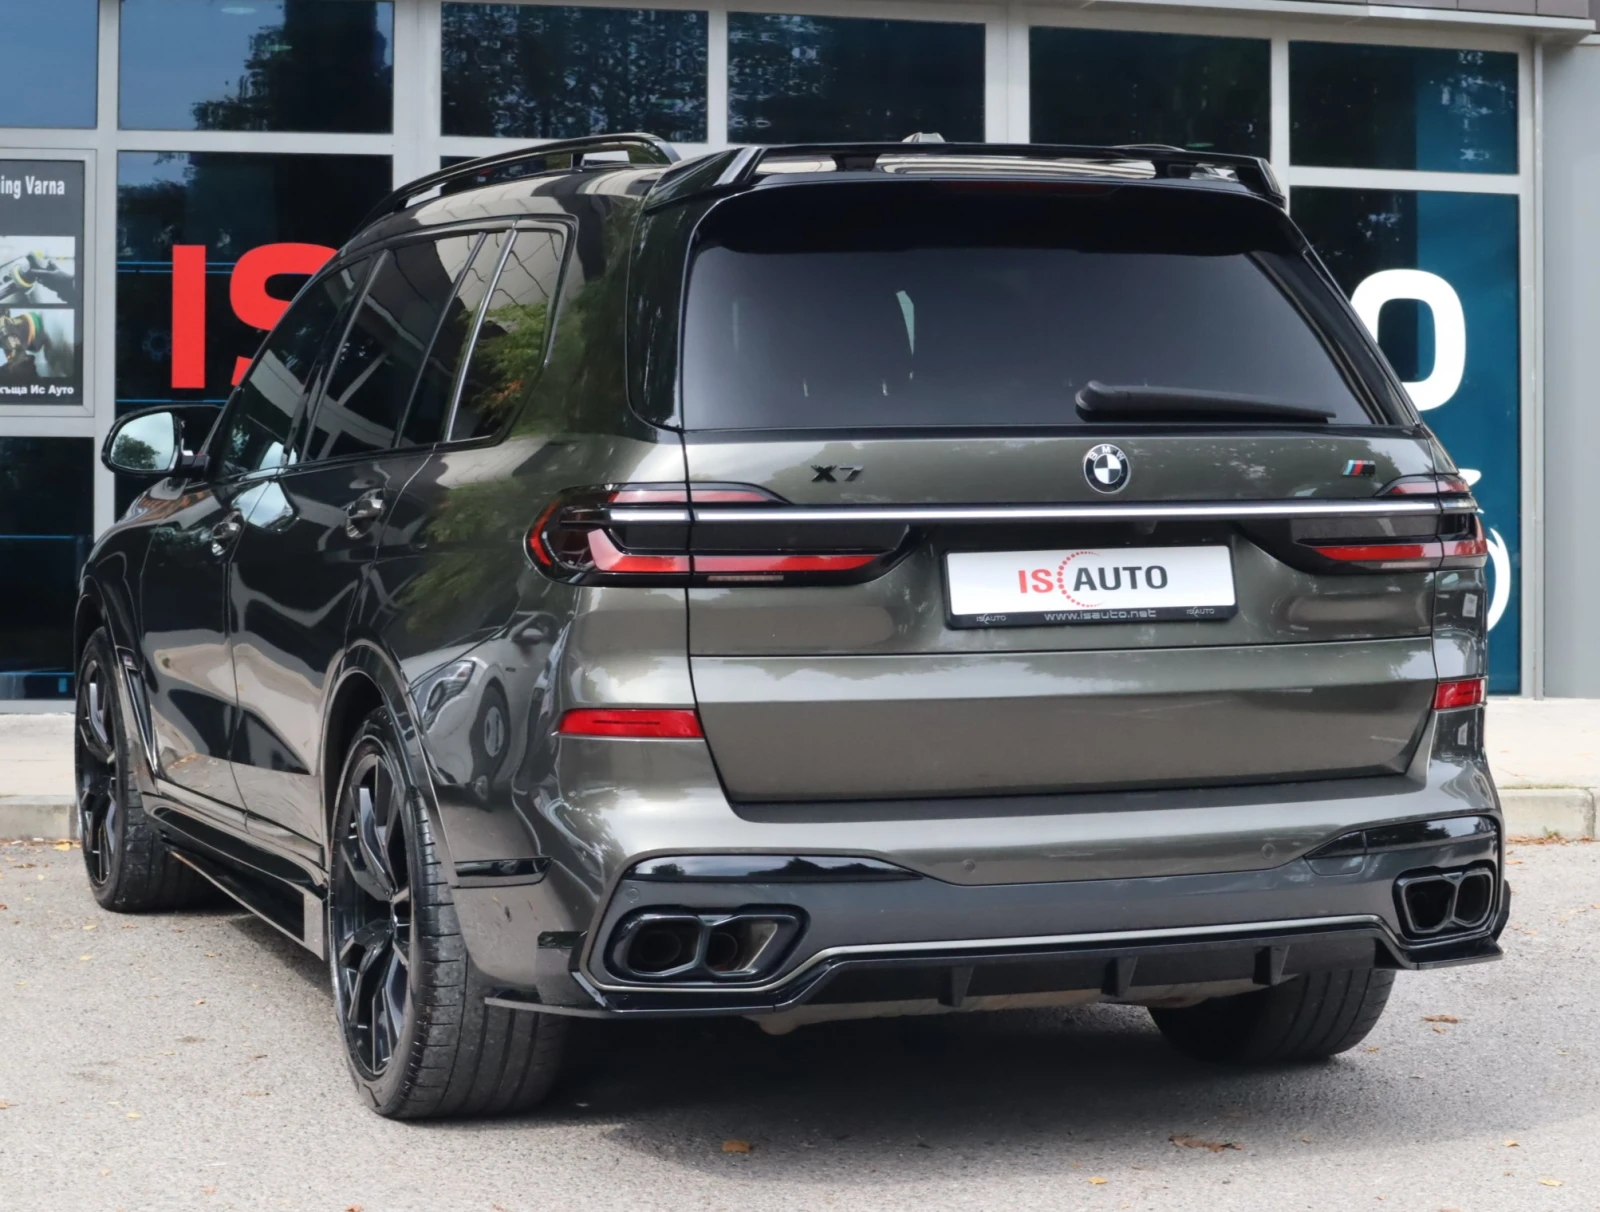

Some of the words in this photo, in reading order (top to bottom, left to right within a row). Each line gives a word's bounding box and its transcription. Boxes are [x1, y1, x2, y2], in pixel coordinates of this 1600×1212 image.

[25, 175, 65, 195] Varna
[30, 384, 45, 394] Ис
[48, 384, 74, 396] Ауто
[811, 464, 864, 483] X7
[1018, 569, 1054, 593] IS
[1073, 565, 1168, 592] AUTO
[1043, 608, 1157, 621] www.isauto.net
